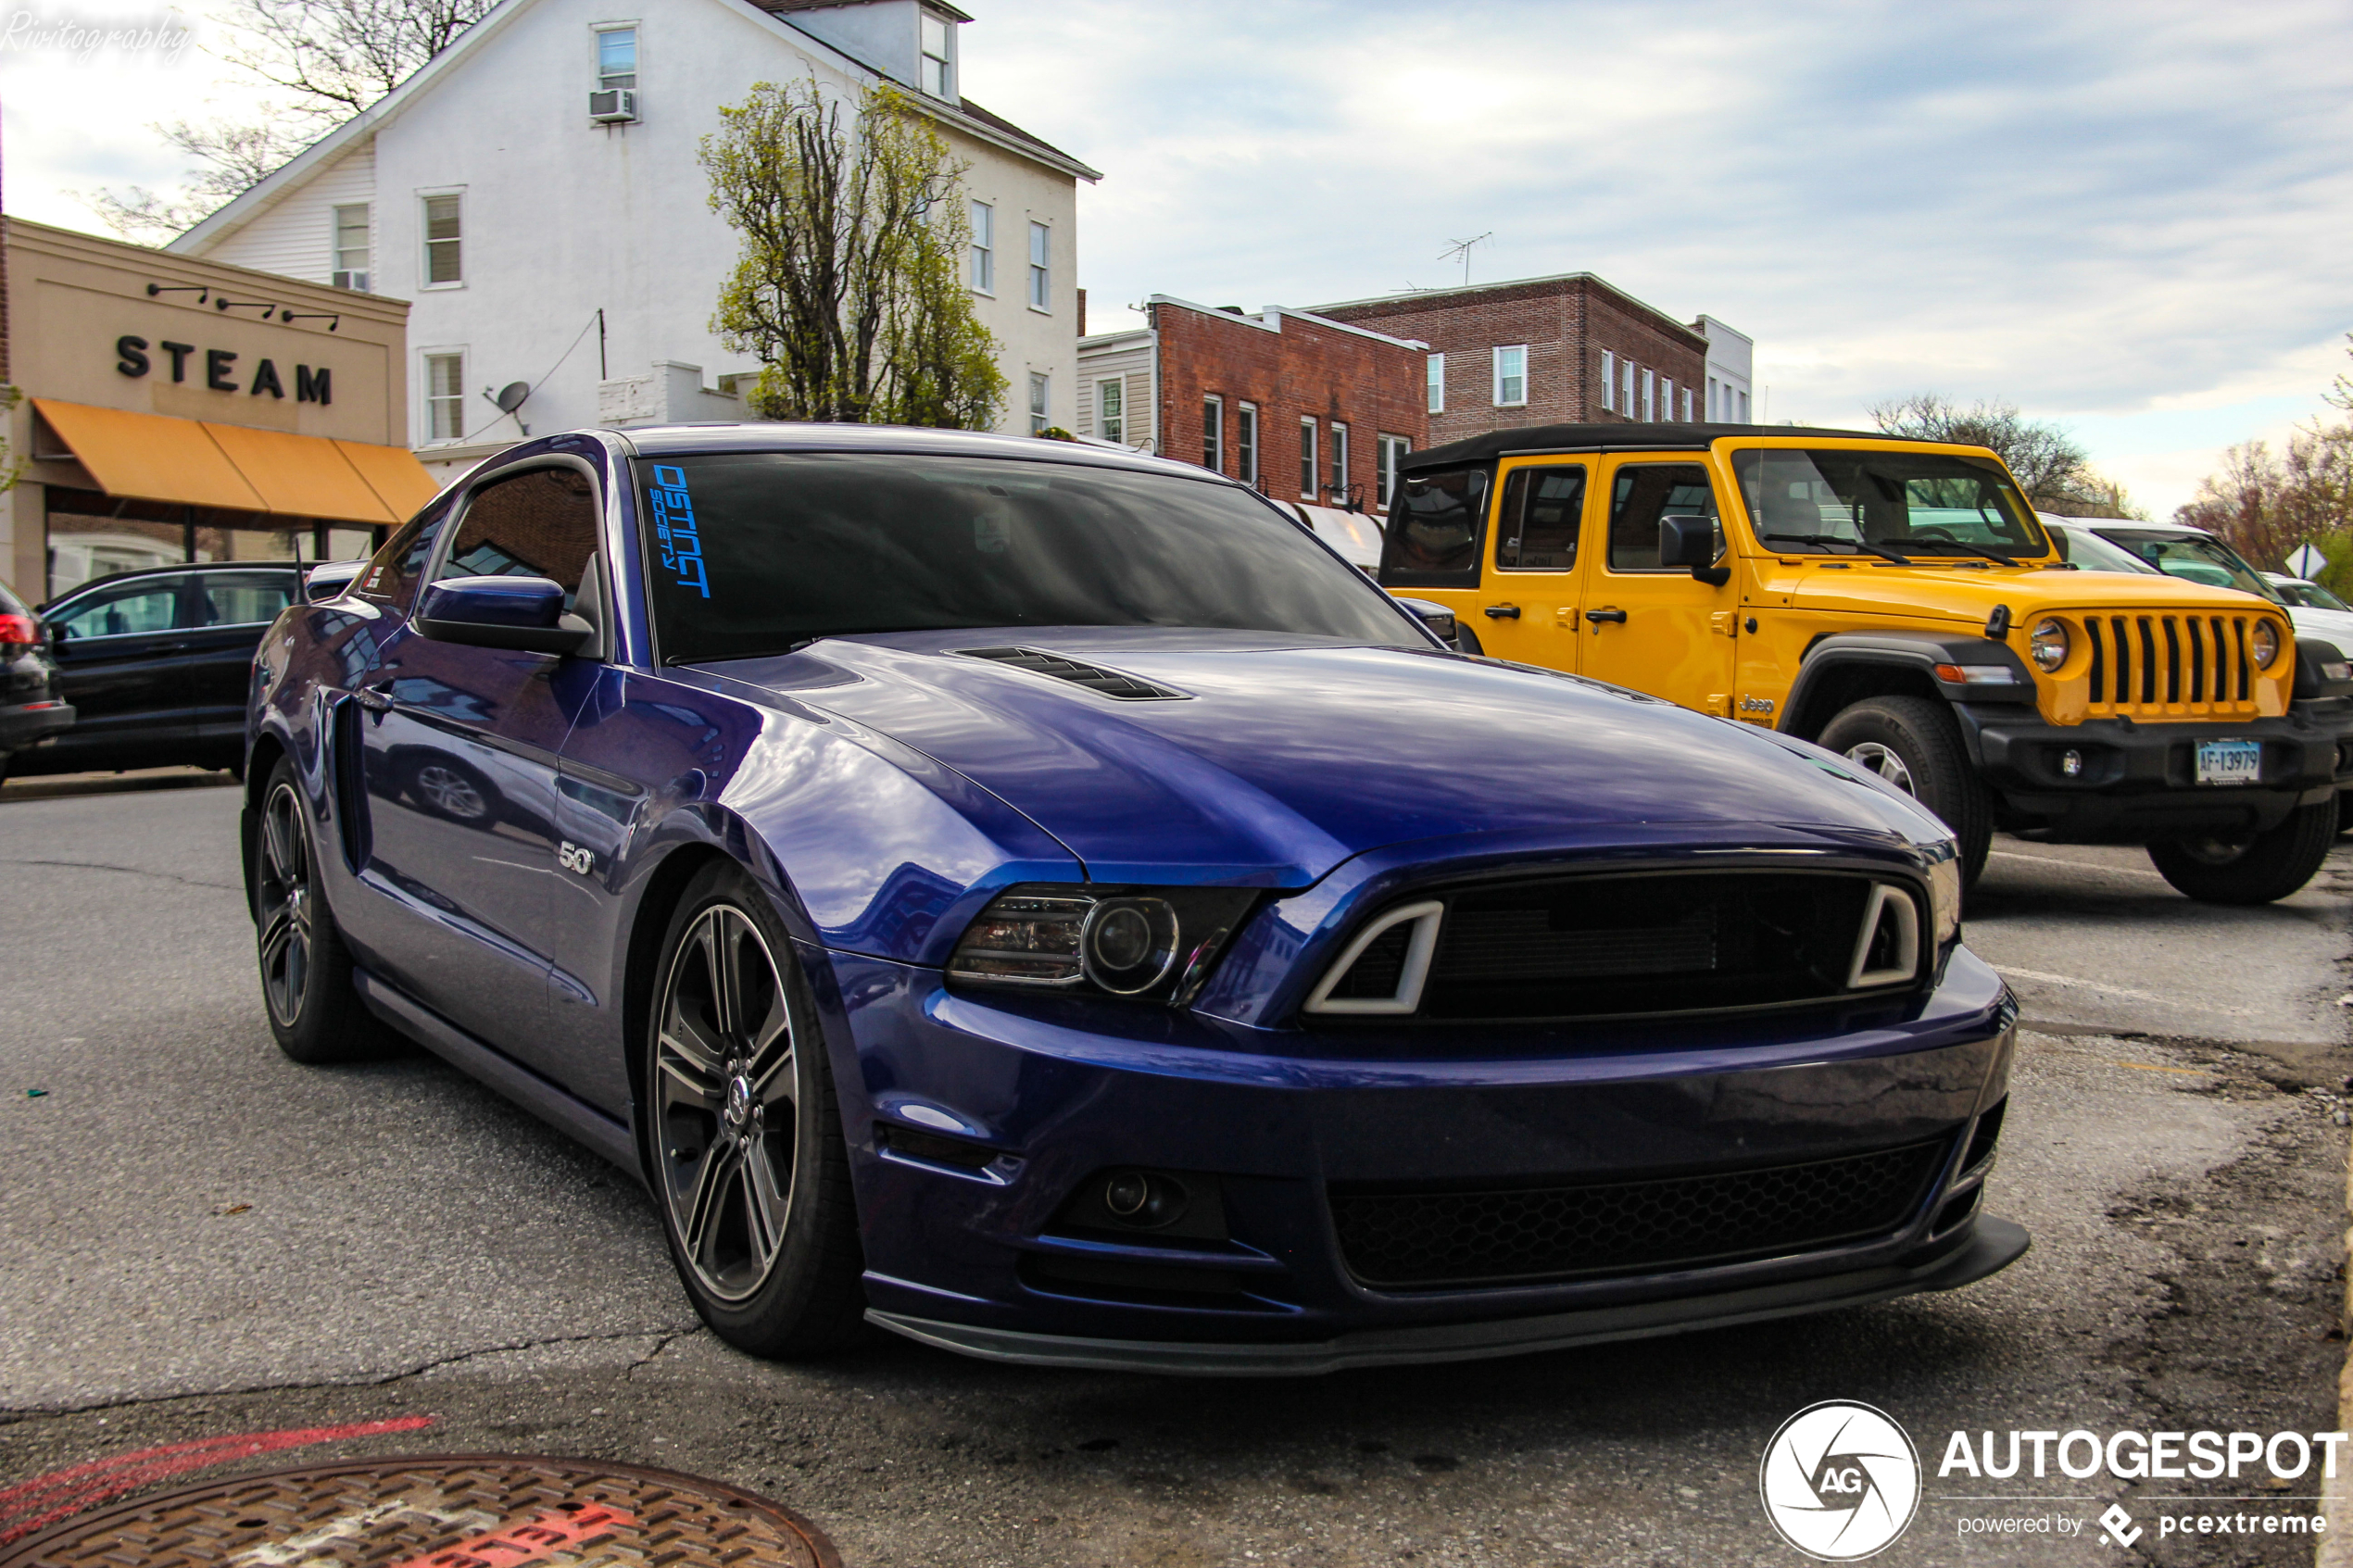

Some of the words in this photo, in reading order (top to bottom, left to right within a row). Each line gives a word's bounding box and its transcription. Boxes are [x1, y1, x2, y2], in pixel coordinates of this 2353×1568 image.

[117, 335, 333, 406] STEAM
[649, 488, 677, 571] SOCIETY
[653, 464, 711, 598] DISTINCT
[1739, 694, 1774, 715] Jeep
